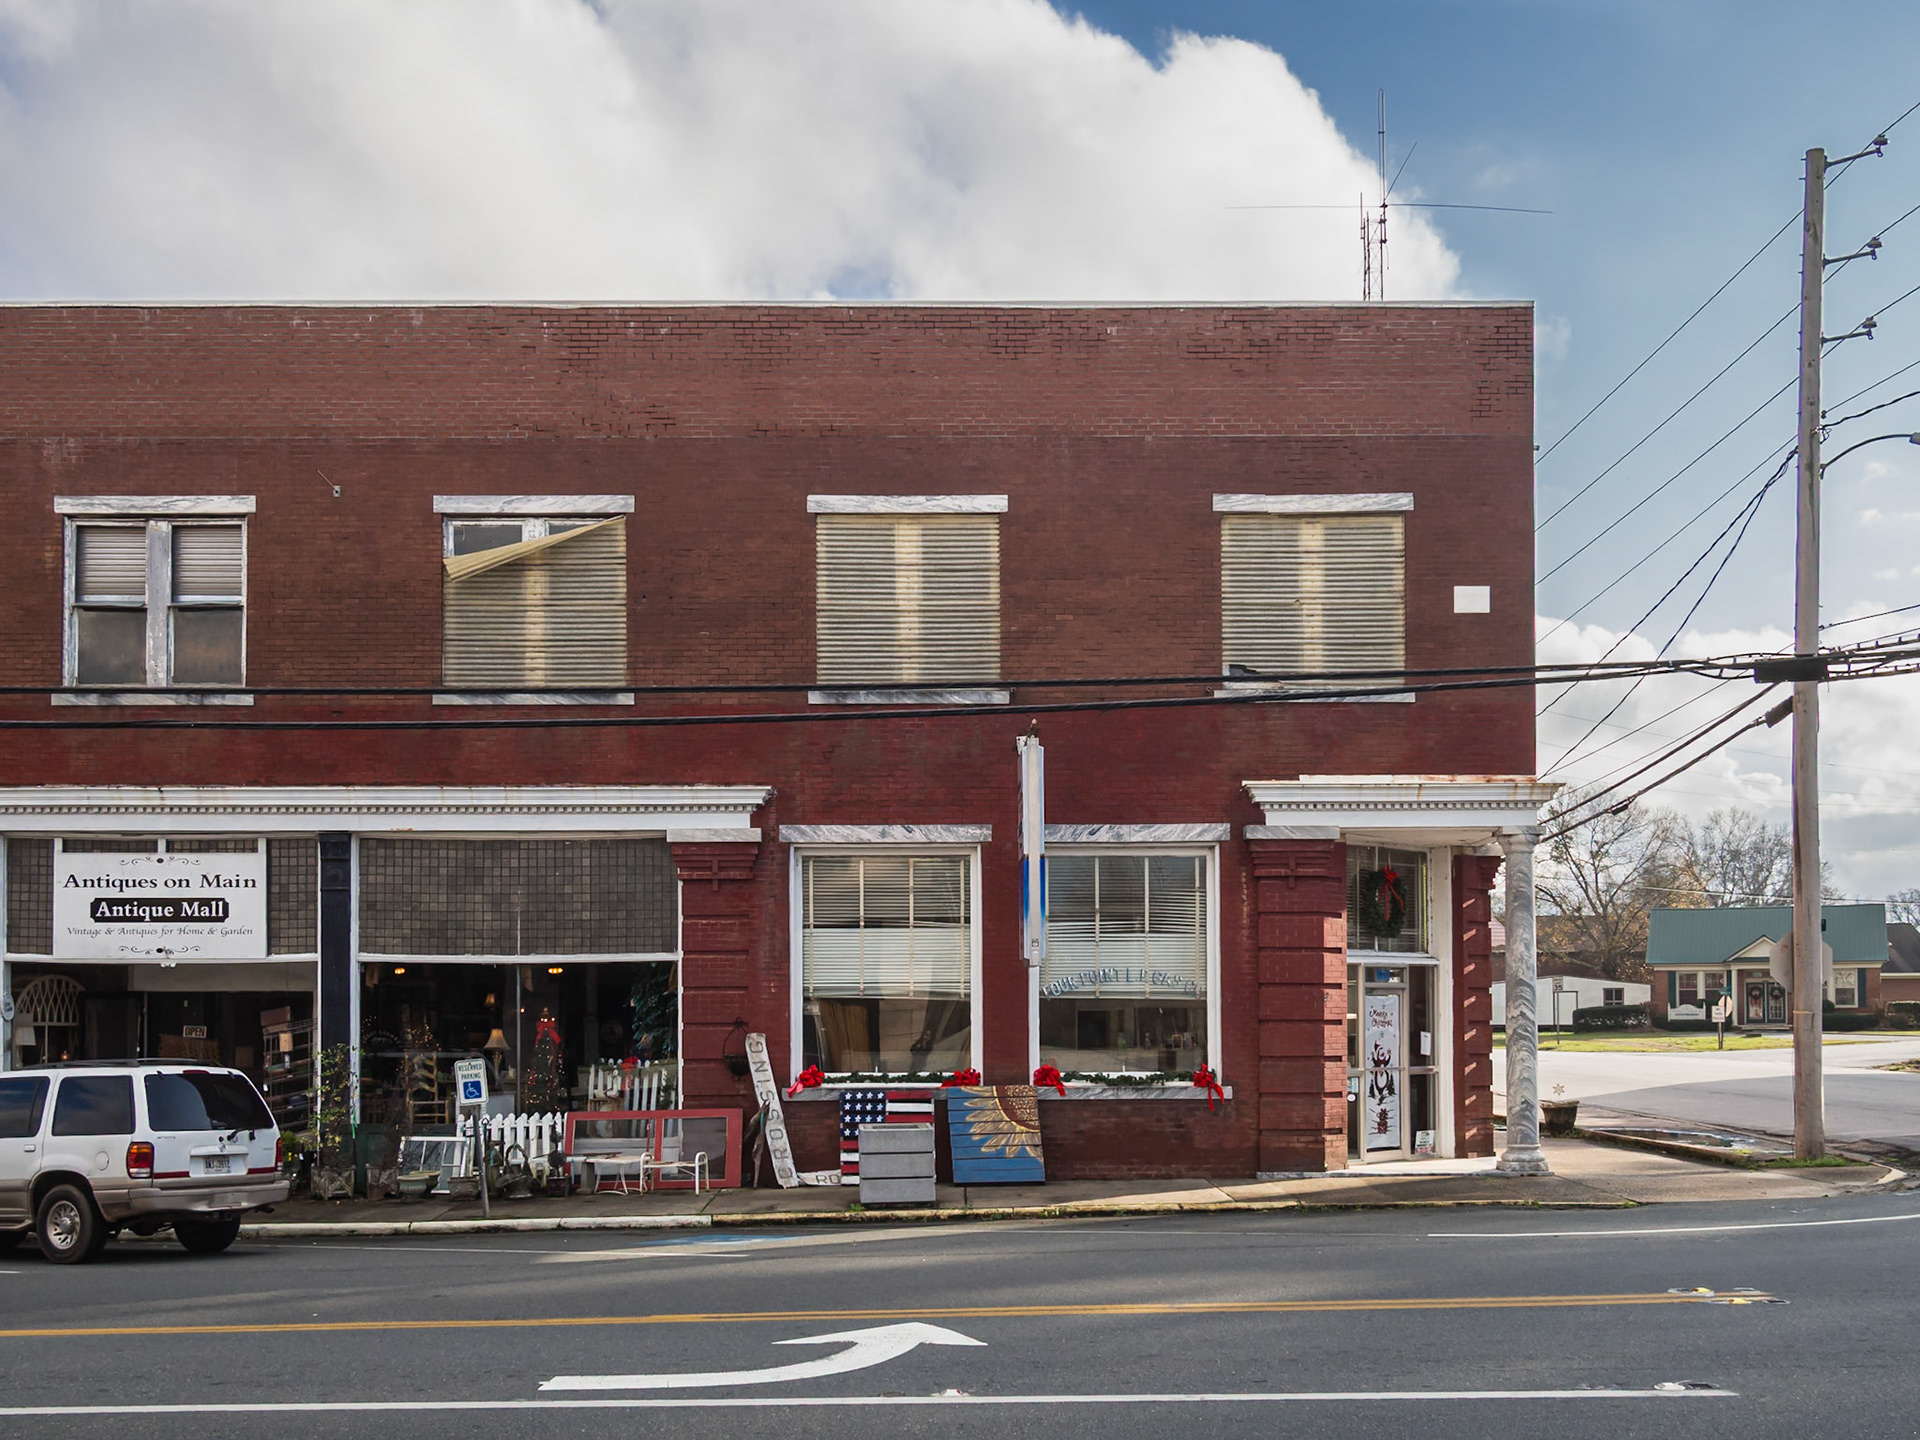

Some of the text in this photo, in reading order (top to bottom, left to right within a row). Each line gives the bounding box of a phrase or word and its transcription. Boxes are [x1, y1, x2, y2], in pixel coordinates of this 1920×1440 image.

[62, 873, 257, 893] Antiques on Main
[95, 901, 224, 922] Antique Mall
[66, 926, 253, 939] Vintage & Antiques for Home & Garden
[185, 1026, 206, 1037] OPEN
[458, 1063, 482, 1072] RESERVED
[461, 1072, 481, 1081] PARKING
[749, 1040, 794, 1179] CROSSING
